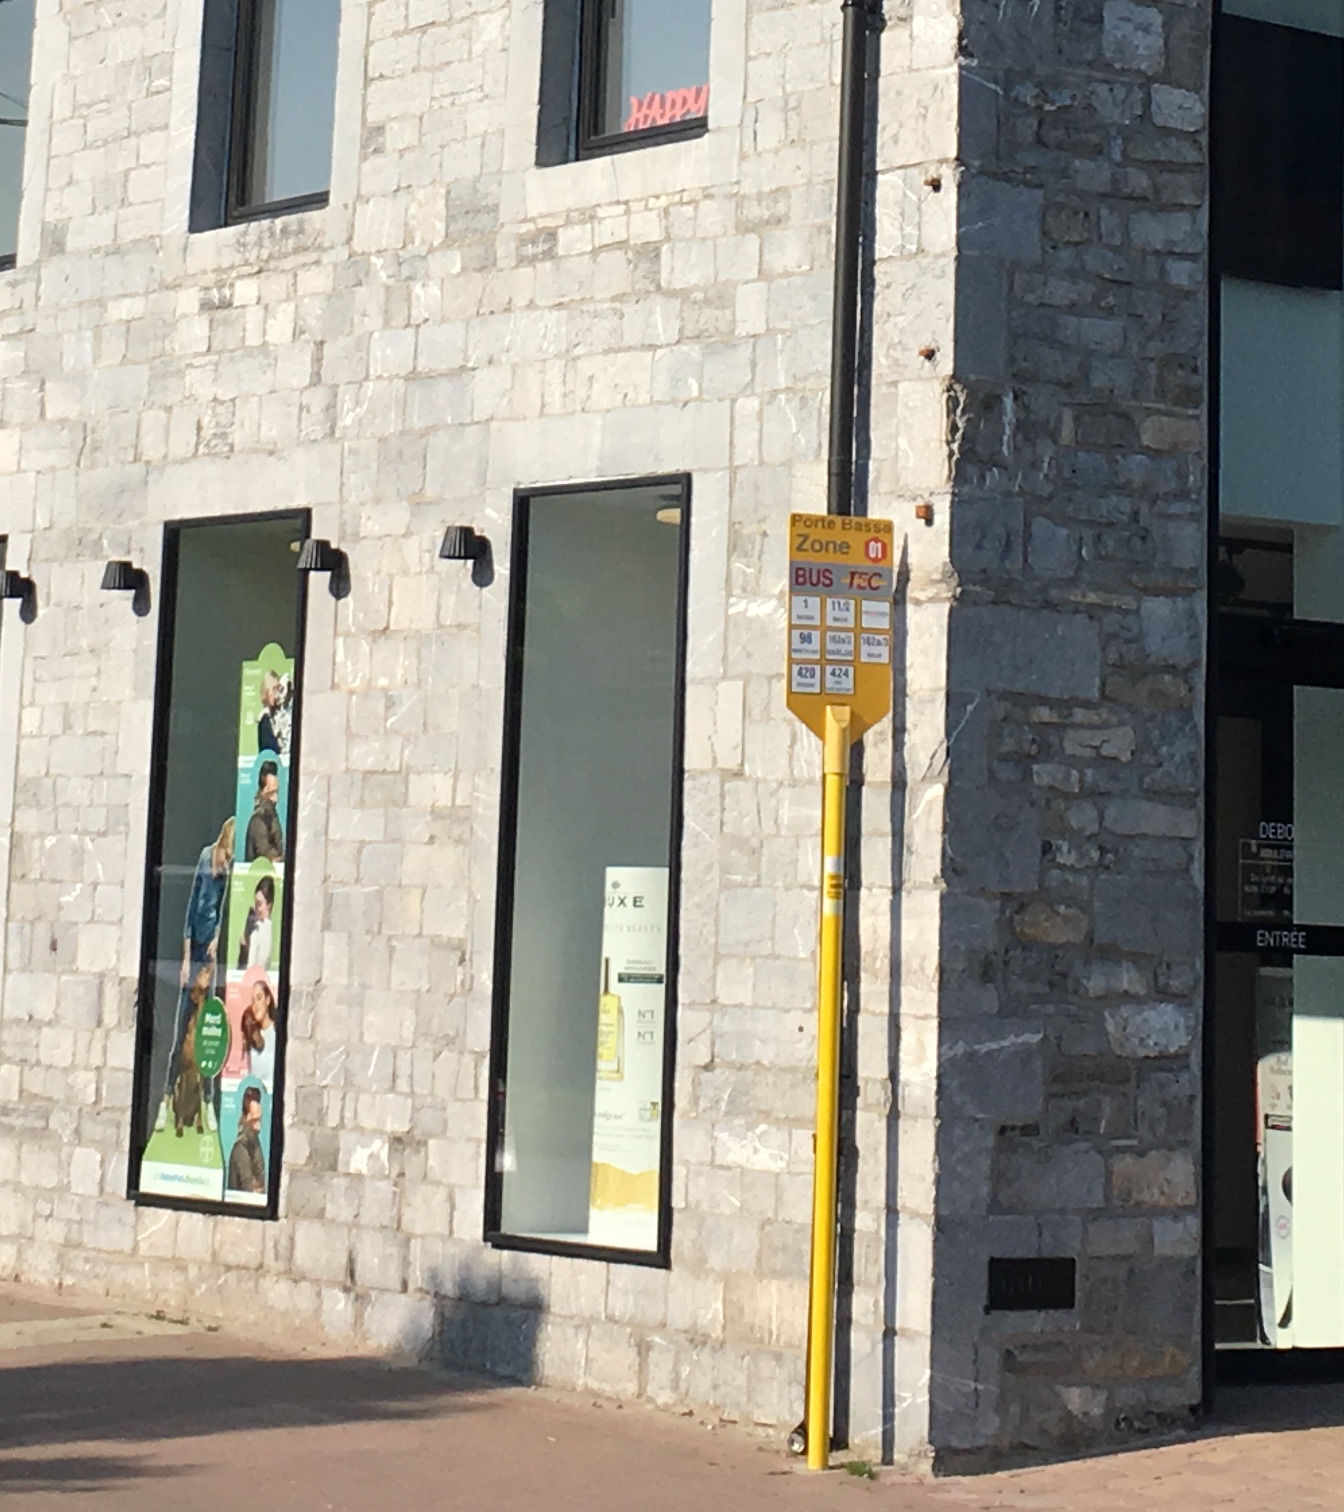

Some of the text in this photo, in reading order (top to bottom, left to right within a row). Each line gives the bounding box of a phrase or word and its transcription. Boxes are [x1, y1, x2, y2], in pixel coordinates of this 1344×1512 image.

[792, 514, 836, 530] Porte
[796, 533, 851, 555] Zone
[794, 567, 883, 591] BUS TEC
[1256, 928, 1307, 949] ENTRÉE
